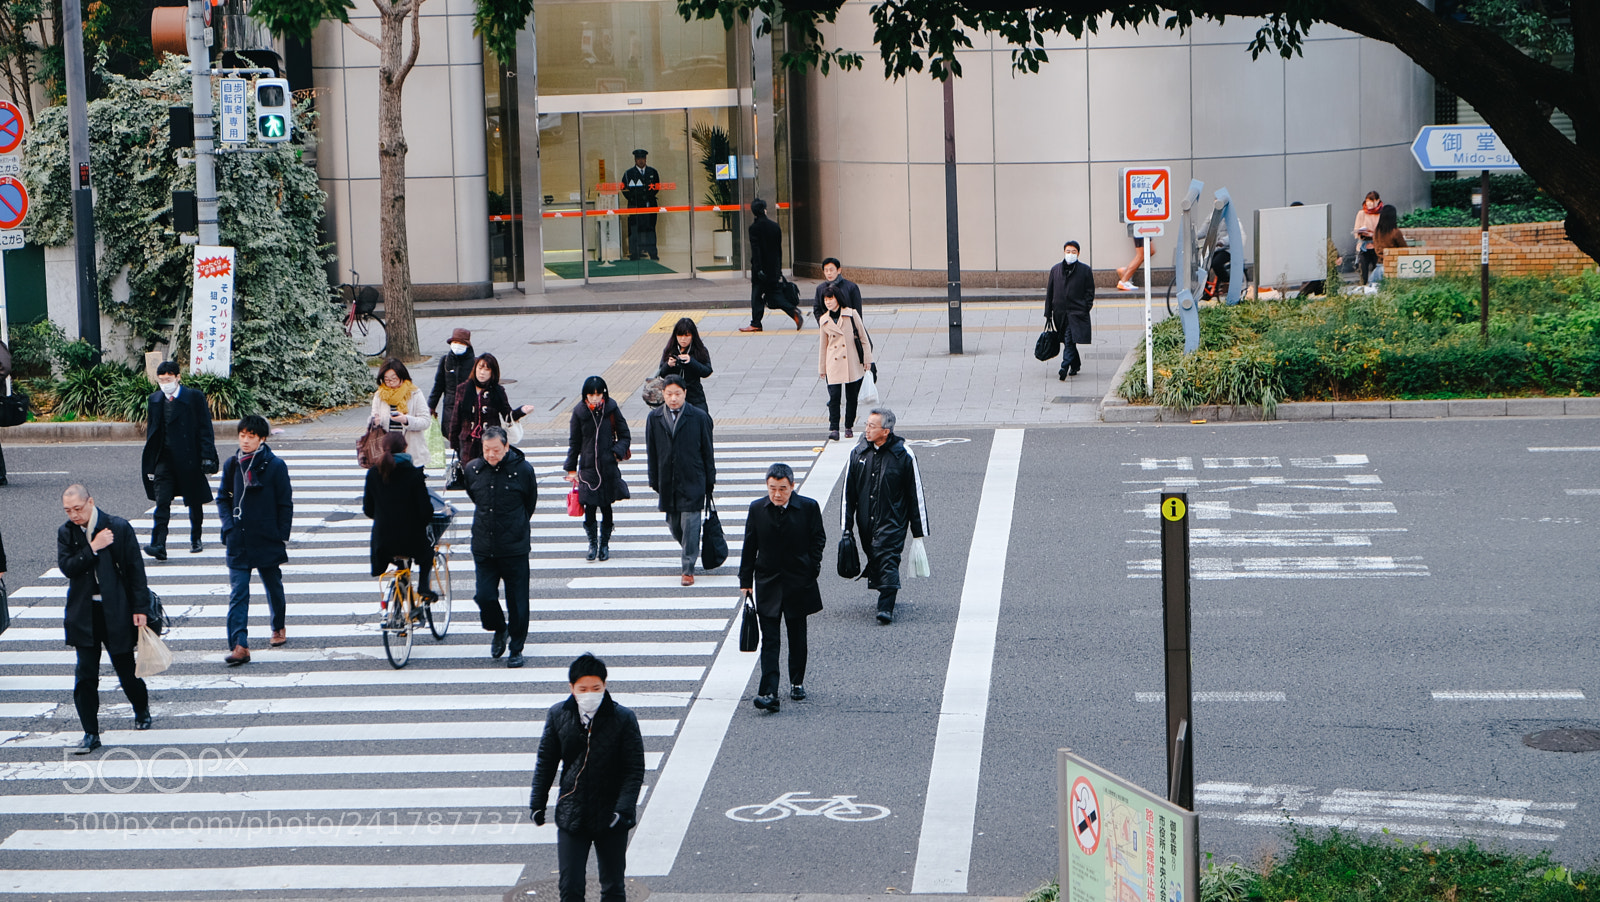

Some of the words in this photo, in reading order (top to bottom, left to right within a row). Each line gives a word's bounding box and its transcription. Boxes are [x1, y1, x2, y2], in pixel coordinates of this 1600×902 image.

[224, 83, 232, 114] 自転車
[233, 83, 242, 114] 歩行者
[229, 117, 238, 138] 専用
[1442, 132, 1497, 152] 御堂
[1400, 259, 1432, 273] F-92
[219, 283, 228, 342] そのバッグ
